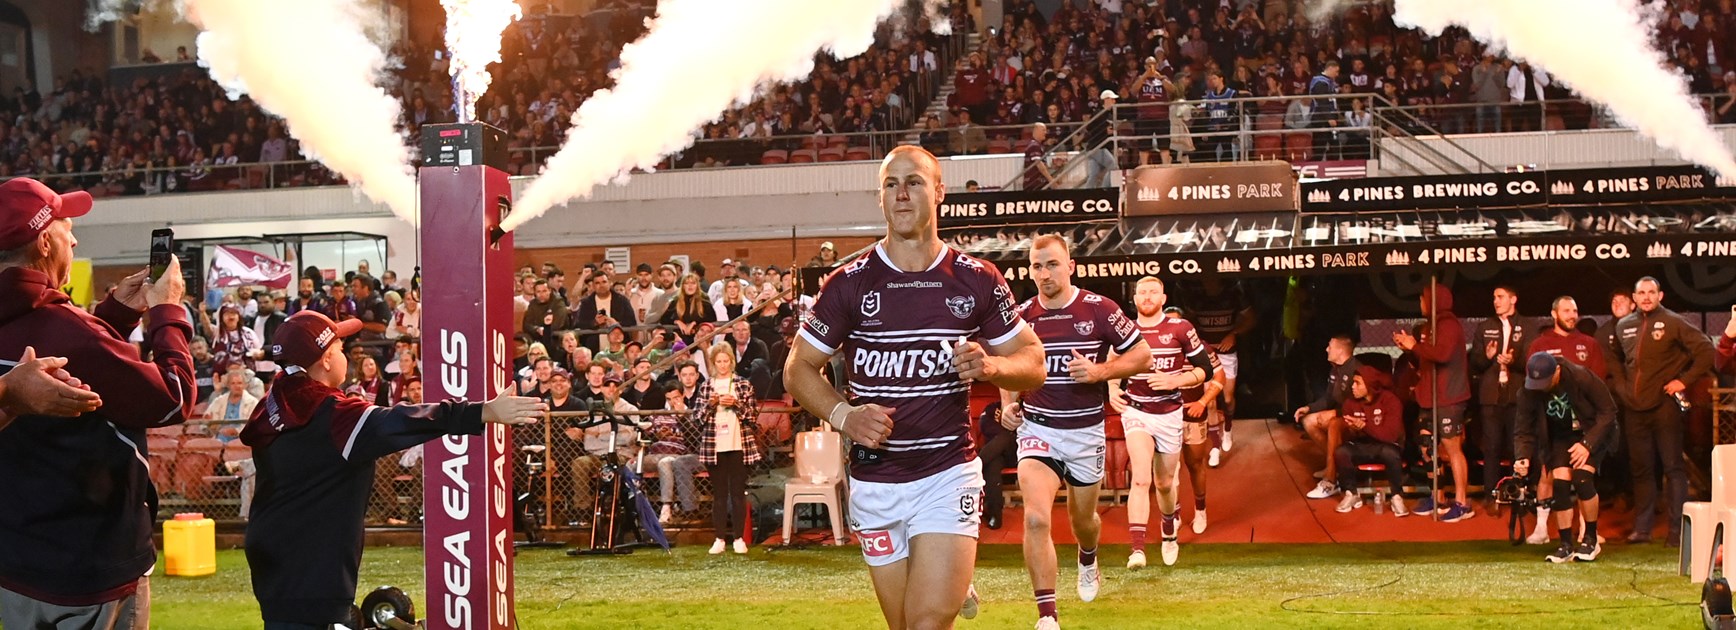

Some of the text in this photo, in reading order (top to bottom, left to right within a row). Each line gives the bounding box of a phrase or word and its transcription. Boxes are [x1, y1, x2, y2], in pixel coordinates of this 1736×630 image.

[1168, 183, 1283, 200] 4 PINES PARK
[1339, 180, 1540, 201] 4 PINES BREWING CO.
[1583, 174, 1704, 193] 4 PINES PARK
[940, 199, 1113, 217] PINES BREWING CO.
[1418, 243, 1631, 264] 4 PINES BREWING CO.
[1681, 241, 1736, 256] 4 PINE
[1077, 259, 1202, 278] BREWING CO.
[1249, 252, 1369, 270] 4 PINES PARK
[1004, 267, 1015, 281] 4
[853, 347, 959, 378] POINTSB
[1021, 438, 1047, 451] KFC
[440, 328, 472, 630] SEA EAGES
[493, 328, 508, 628] SEA EAGES
